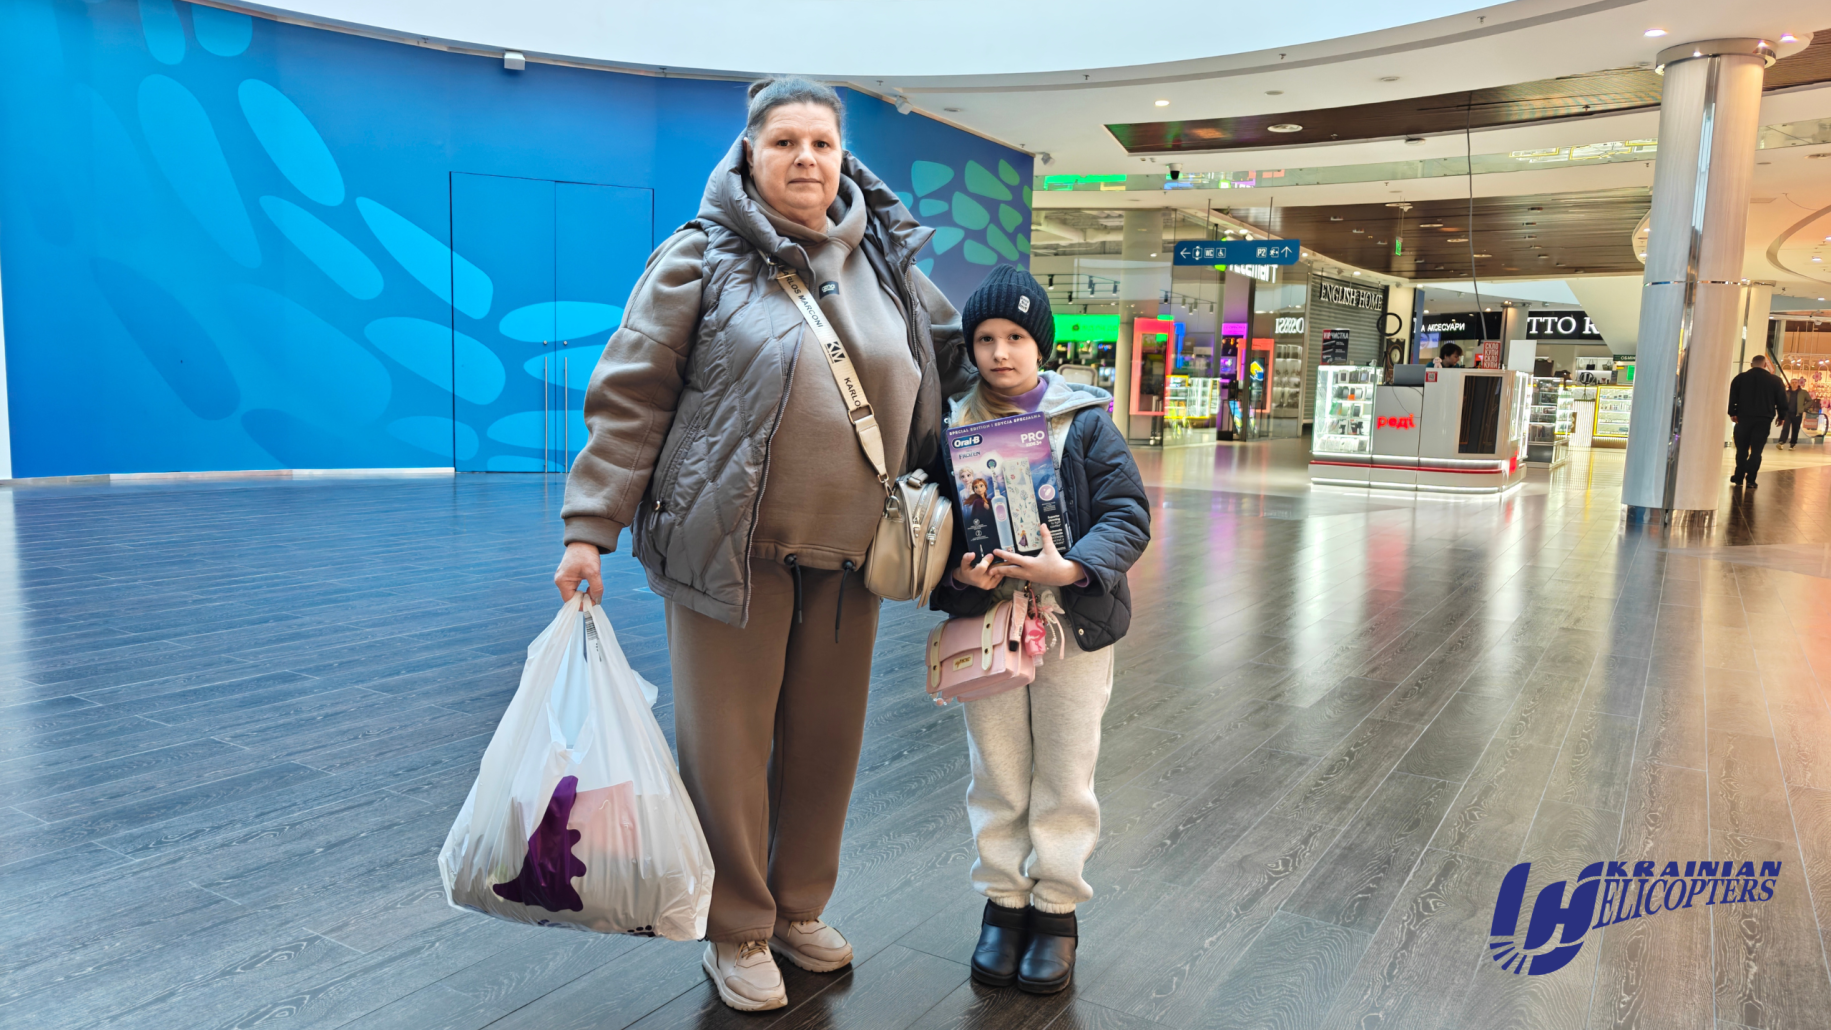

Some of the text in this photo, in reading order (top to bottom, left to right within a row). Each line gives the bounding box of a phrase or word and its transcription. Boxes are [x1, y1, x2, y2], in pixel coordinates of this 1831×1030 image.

[1320, 282, 1383, 311] ENGLISH HOME
[798, 293, 824, 328] MARCONI
[1427, 322, 1466, 332] АКСЕСУАРИ
[1485, 342, 1499, 350] СКЛО
[844, 377, 862, 408] KARLO
[949, 428, 969, 436] SPECIAL
[1020, 431, 1045, 444] PRO
[953, 436, 980, 448] Oral-B
